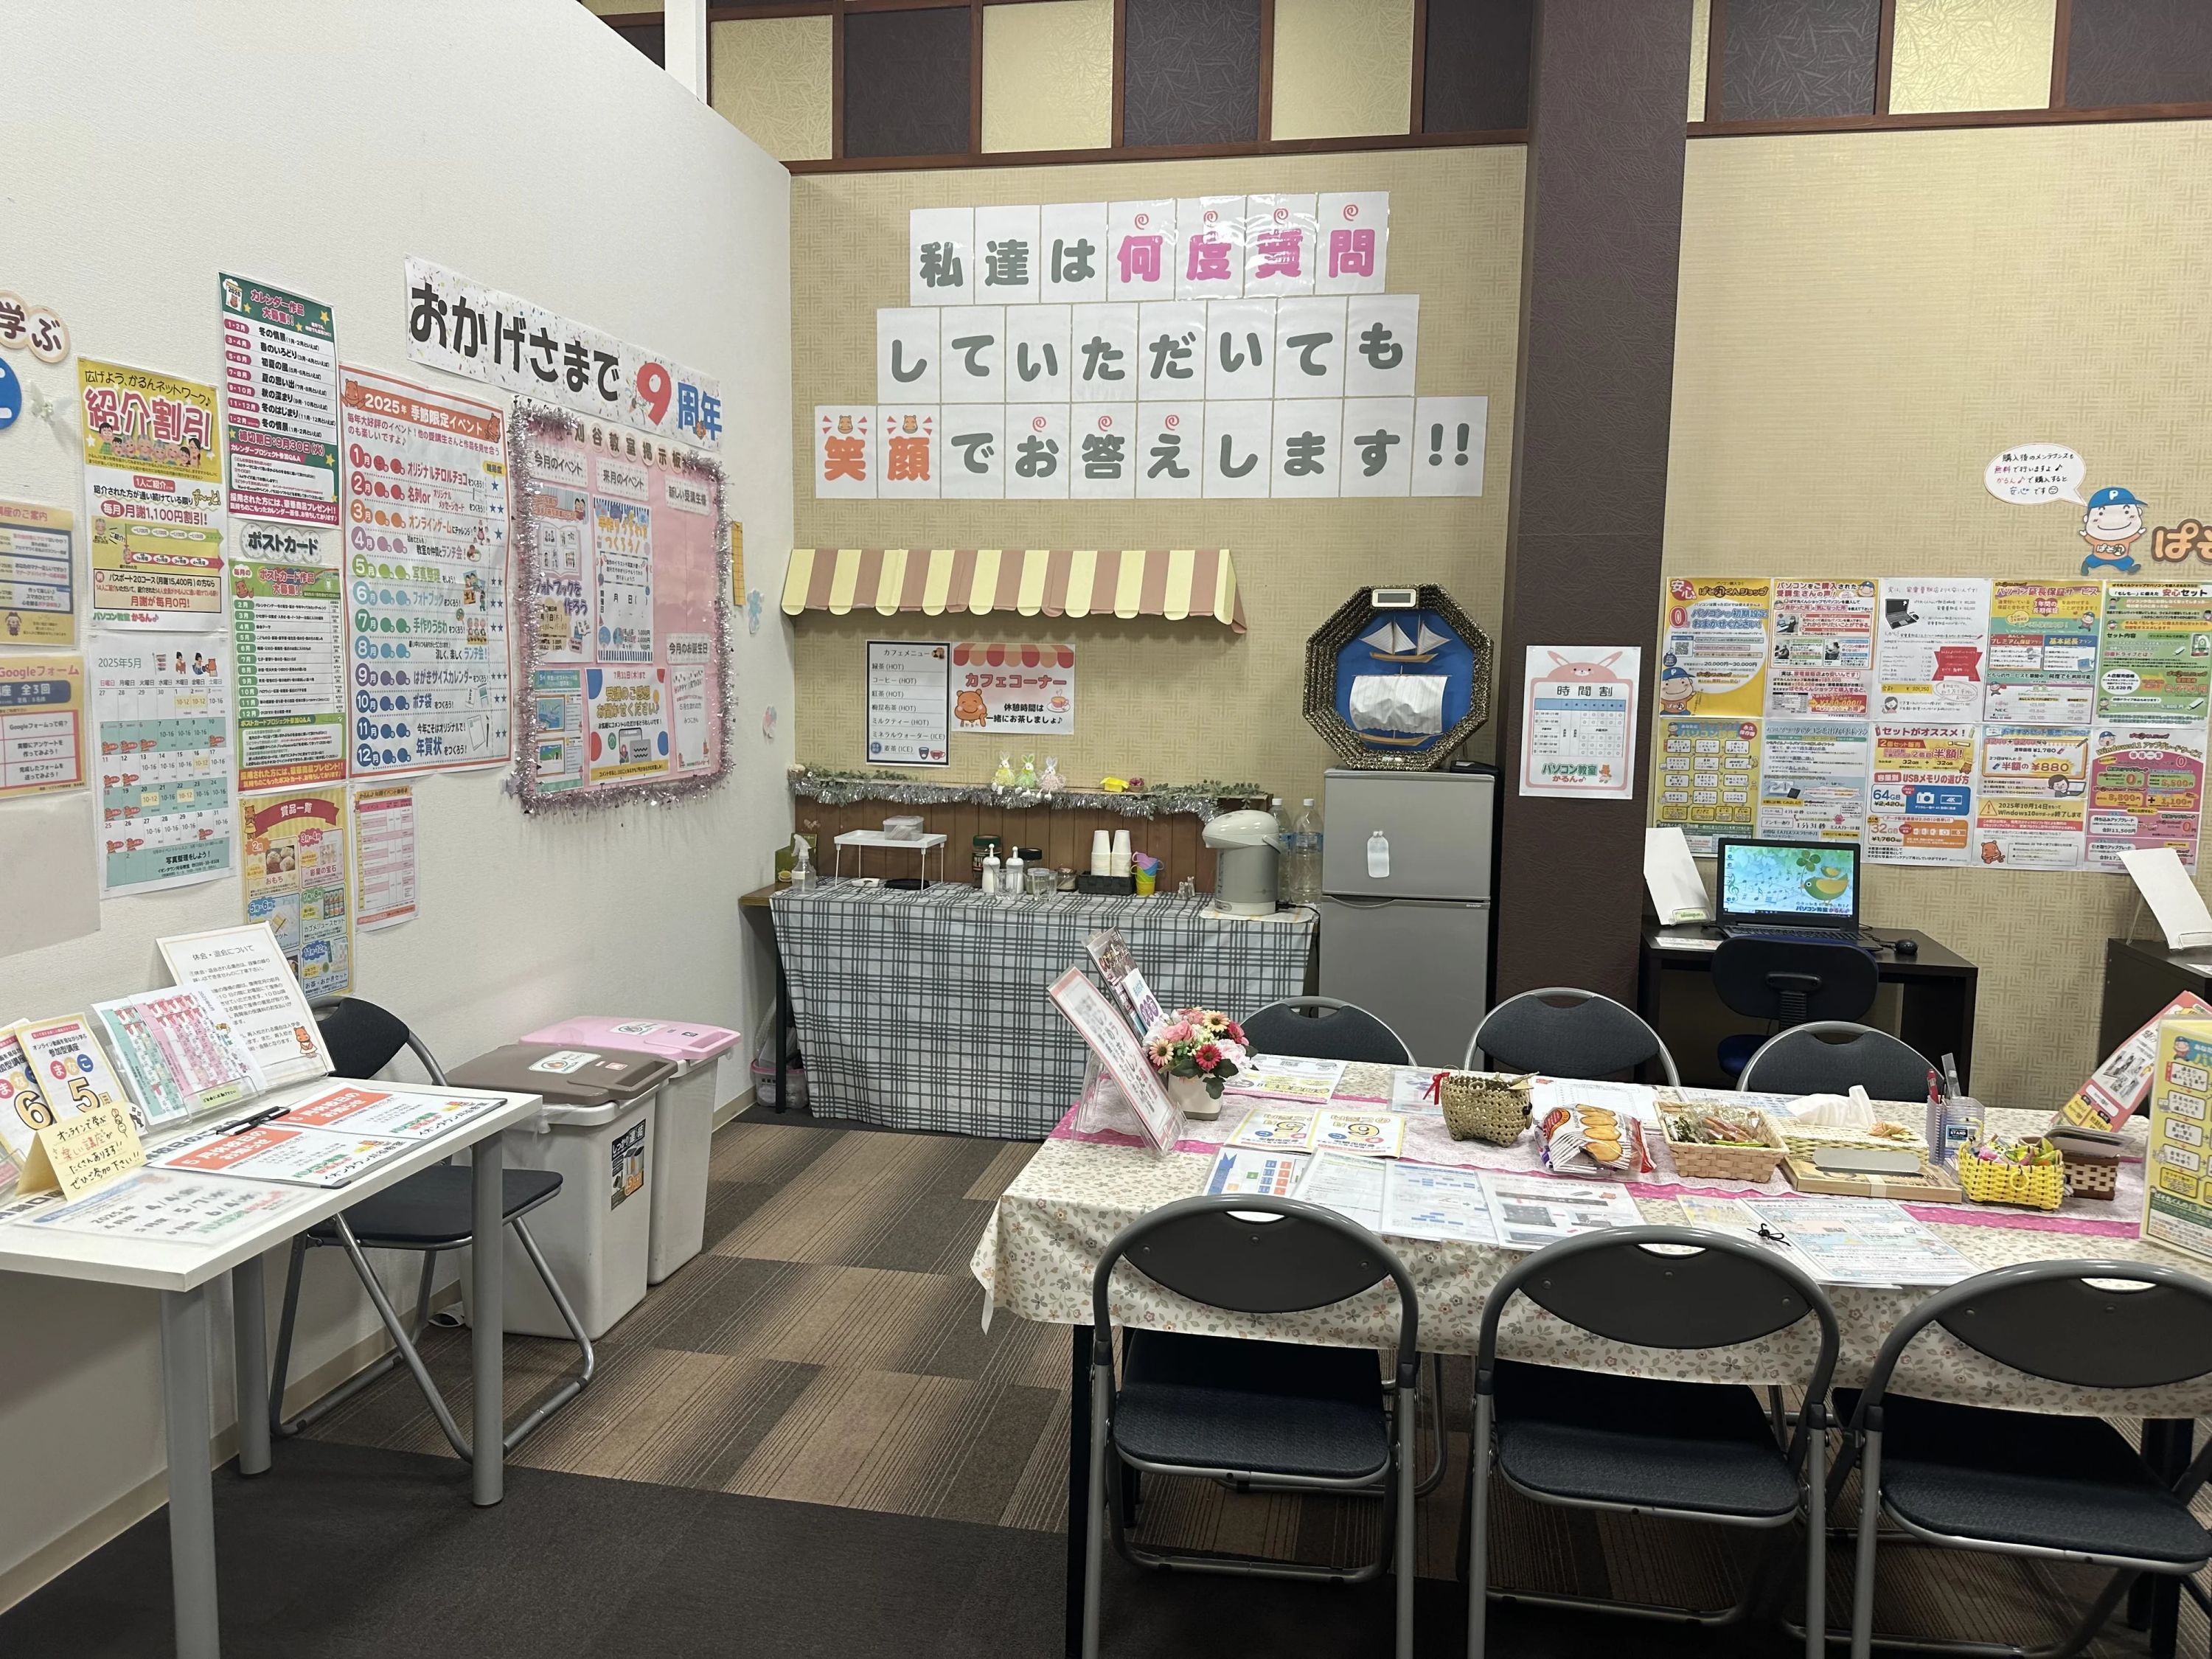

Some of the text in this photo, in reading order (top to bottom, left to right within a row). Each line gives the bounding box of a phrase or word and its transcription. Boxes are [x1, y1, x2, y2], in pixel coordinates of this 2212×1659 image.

[920, 229, 1376, 288] 私達は何度質問
[251, 289, 305, 316] カレンダー作品
[262, 307, 294, 326] 大募集!!
[0, 301, 62, 351] 学ぶ
[891, 322, 1403, 383] していただいても
[83, 387, 212, 450] 紹介割引
[365, 394, 482, 435] 2025年 季節限定イベント
[824, 423, 1470, 481] 笑顔でお答えします!!
[534, 451, 582, 475] 今月のイベント
[603, 470, 644, 490] 来月のイベント
[2109, 490, 2118, 501] P
[102, 503, 121, 515] 毎月
[248, 532, 319, 555] ポストカード
[234, 568, 251, 577] 毎月の
[131, 597, 190, 608] 月謝が毎月0円!
[564, 598, 588, 616] 作ろう
[413, 617, 448, 633] 手作りうちわ
[669, 642, 708, 655] 今月のお誕生日
[98, 658, 142, 669] 2025年5月
[0, 665, 80, 680] Googleフォーム
[899, 677, 917, 685] (HOT)
[966, 672, 1067, 689] カフェコーナー
[21, 684, 51, 695] 全3回
[886, 690, 904, 698] (HOT)
[1557, 686, 1613, 697] 時間割
[358, 693, 431, 710] 10月 ポチ袋
[1004, 703, 1044, 712] 休憩時間は
[1882, 727, 1965, 737] セットがオススメ!
[358, 736, 442, 763] 12月 年賀状
[898, 745, 913, 753] (ICE)
[1542, 763, 1597, 776] パソコン教室
[1903, 775, 1969, 784] USBメモリの選び方
[1873, 789, 1901, 800] 64GB
[280, 802, 313, 818] 賞品一覧
[1871, 824, 1898, 834] 32GB
[252, 842, 262, 852] 2月
[265, 876, 283, 885] おもち
[49, 1046, 80, 1057] 参加型講座
[14, 1091, 54, 1131] 6
